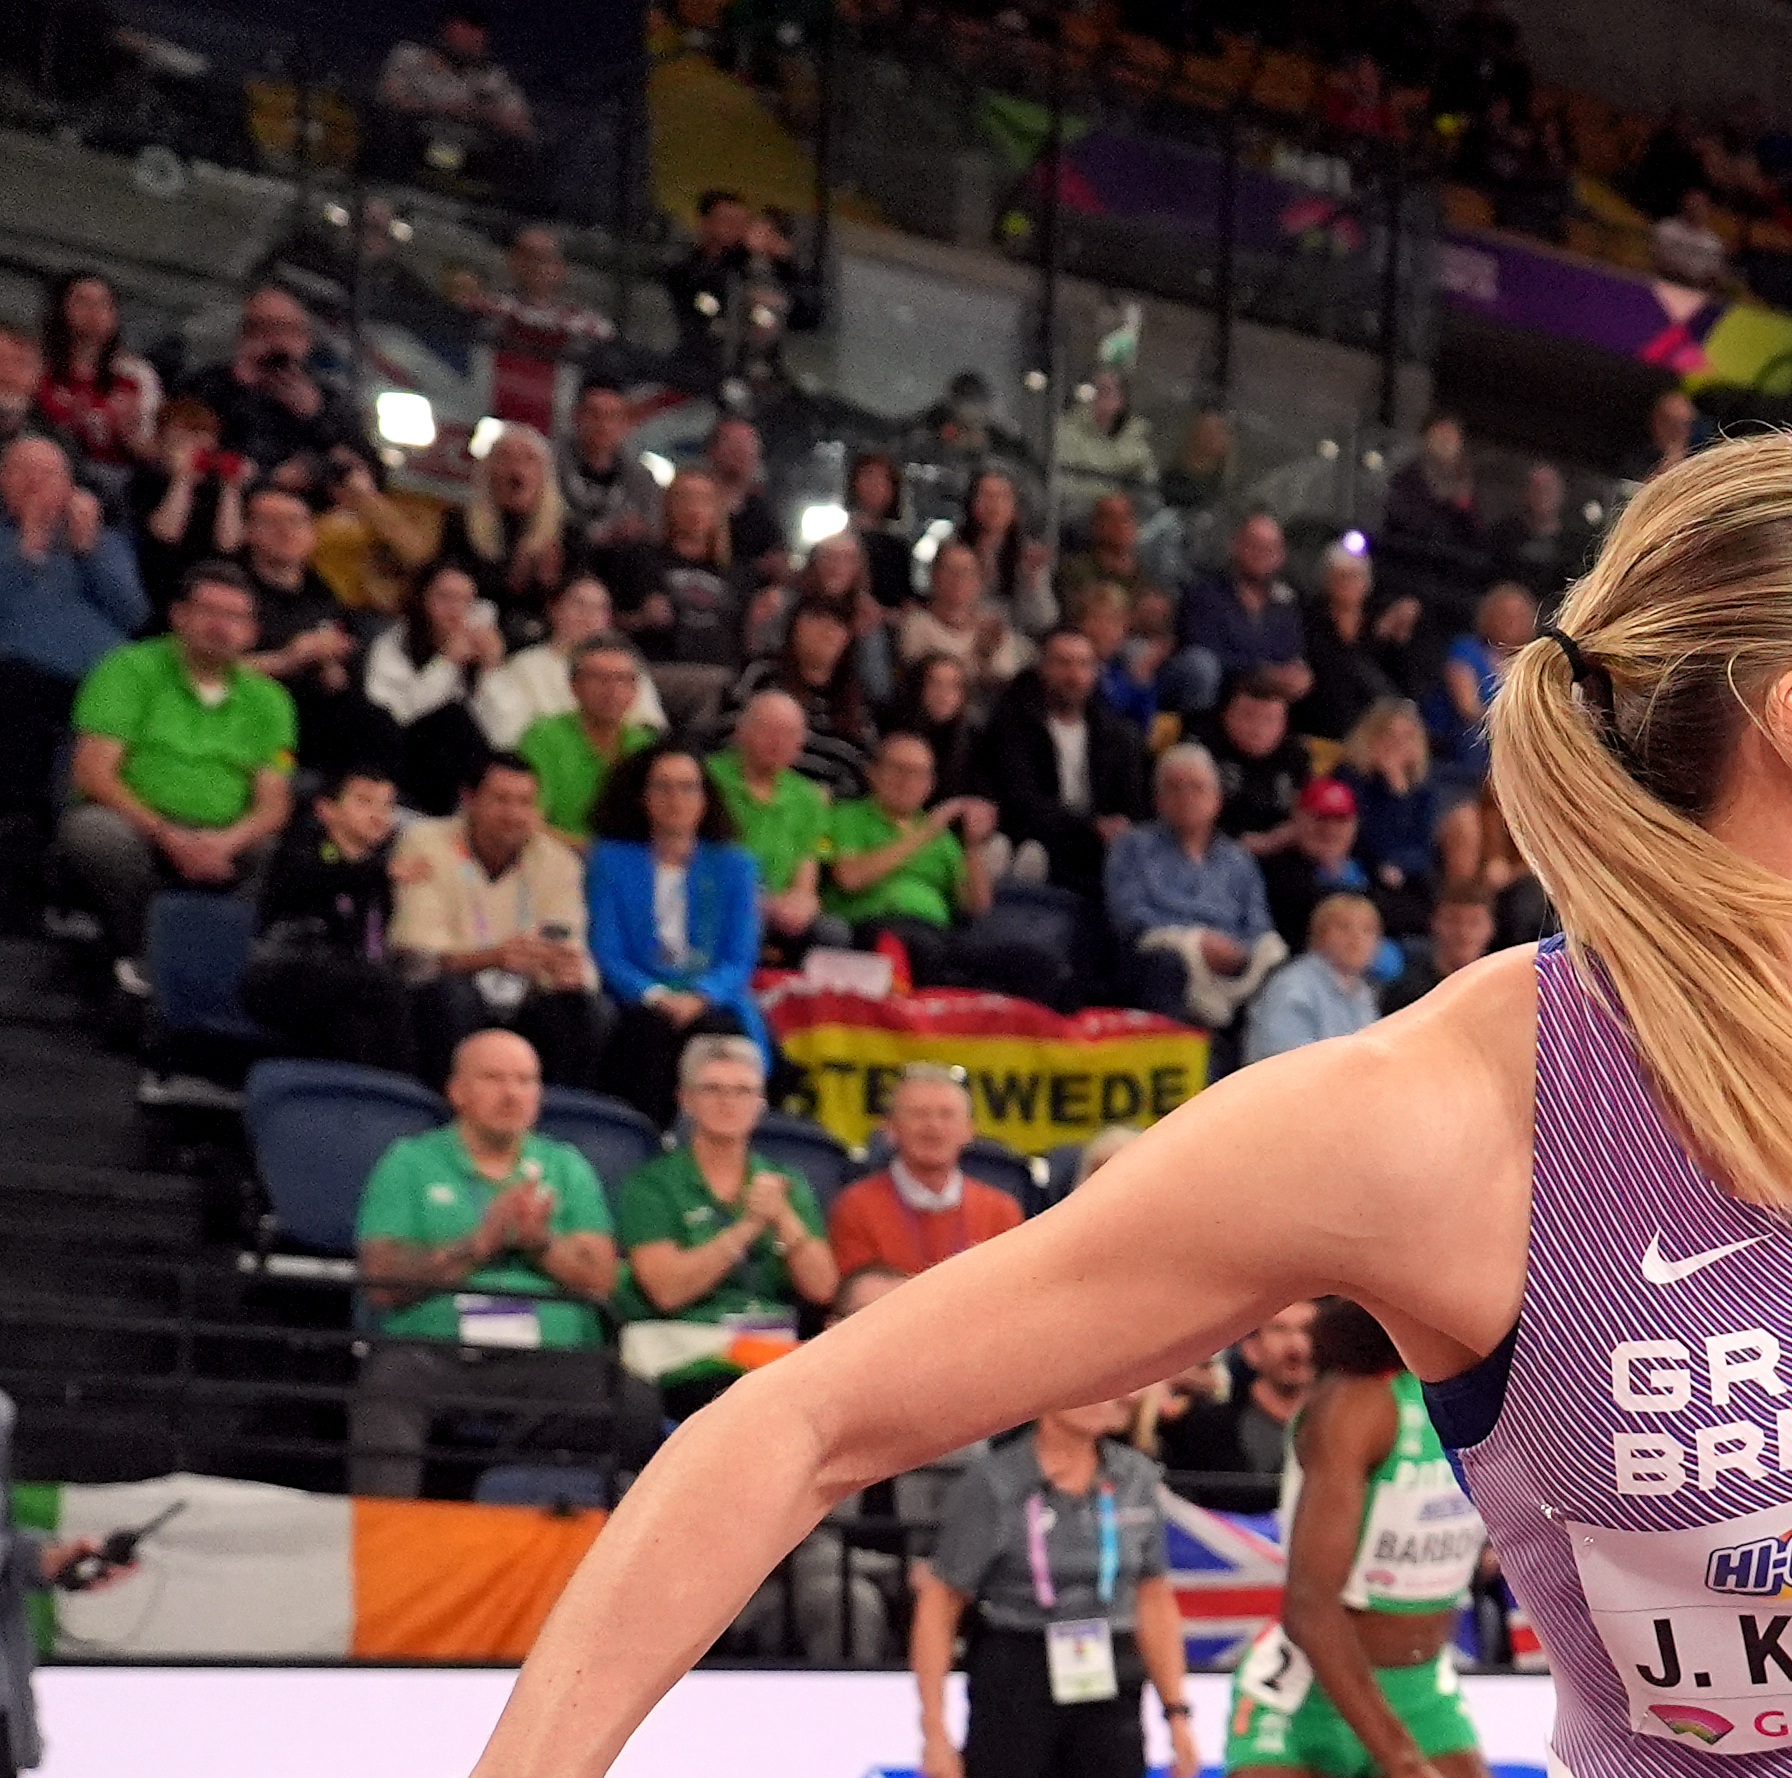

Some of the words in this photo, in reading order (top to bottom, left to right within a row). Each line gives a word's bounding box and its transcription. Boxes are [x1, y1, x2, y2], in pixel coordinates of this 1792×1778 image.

[784, 1060, 1187, 1127] STEWEDE
[1373, 1523, 1485, 1567] BARBO
[1262, 1646, 1293, 1693] 2
[1635, 1618, 1712, 1689] J.
